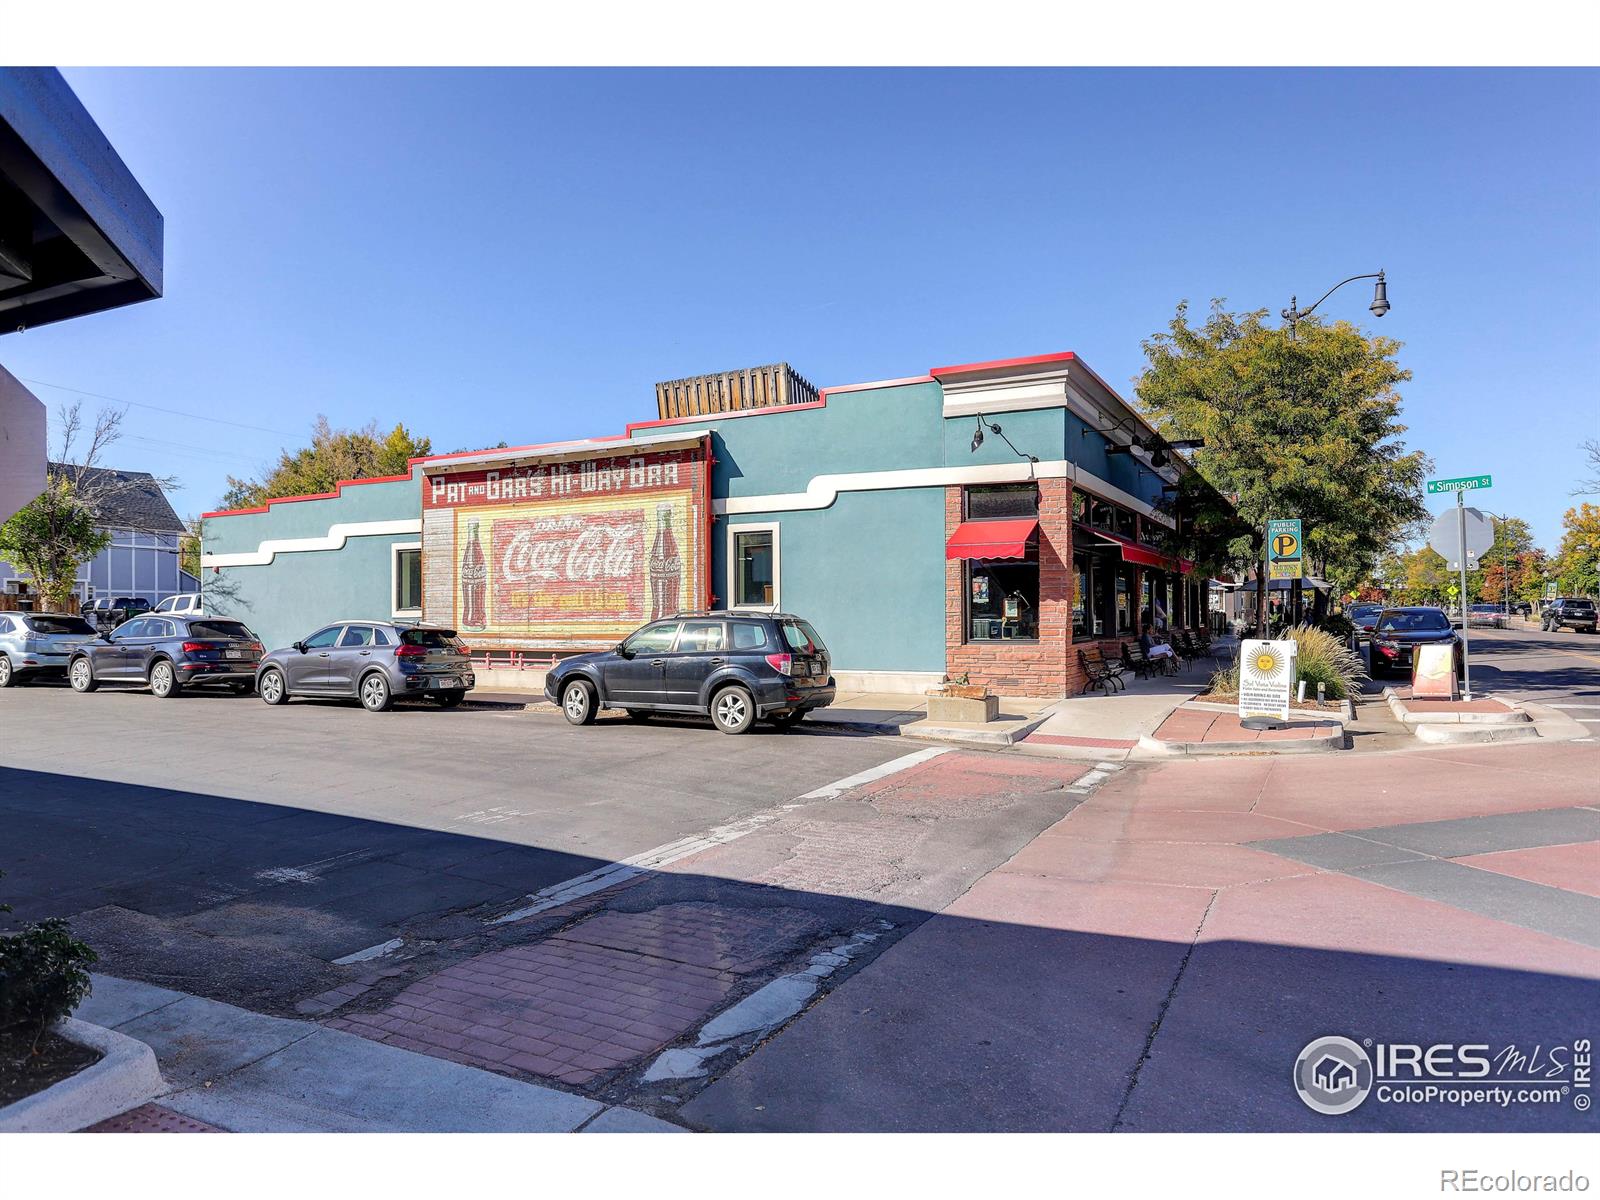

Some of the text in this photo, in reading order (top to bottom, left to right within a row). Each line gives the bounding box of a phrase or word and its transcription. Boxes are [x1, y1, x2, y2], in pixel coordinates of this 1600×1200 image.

[468, 485, 485, 495] AND
[1428, 478, 1489, 491] W Simpson St
